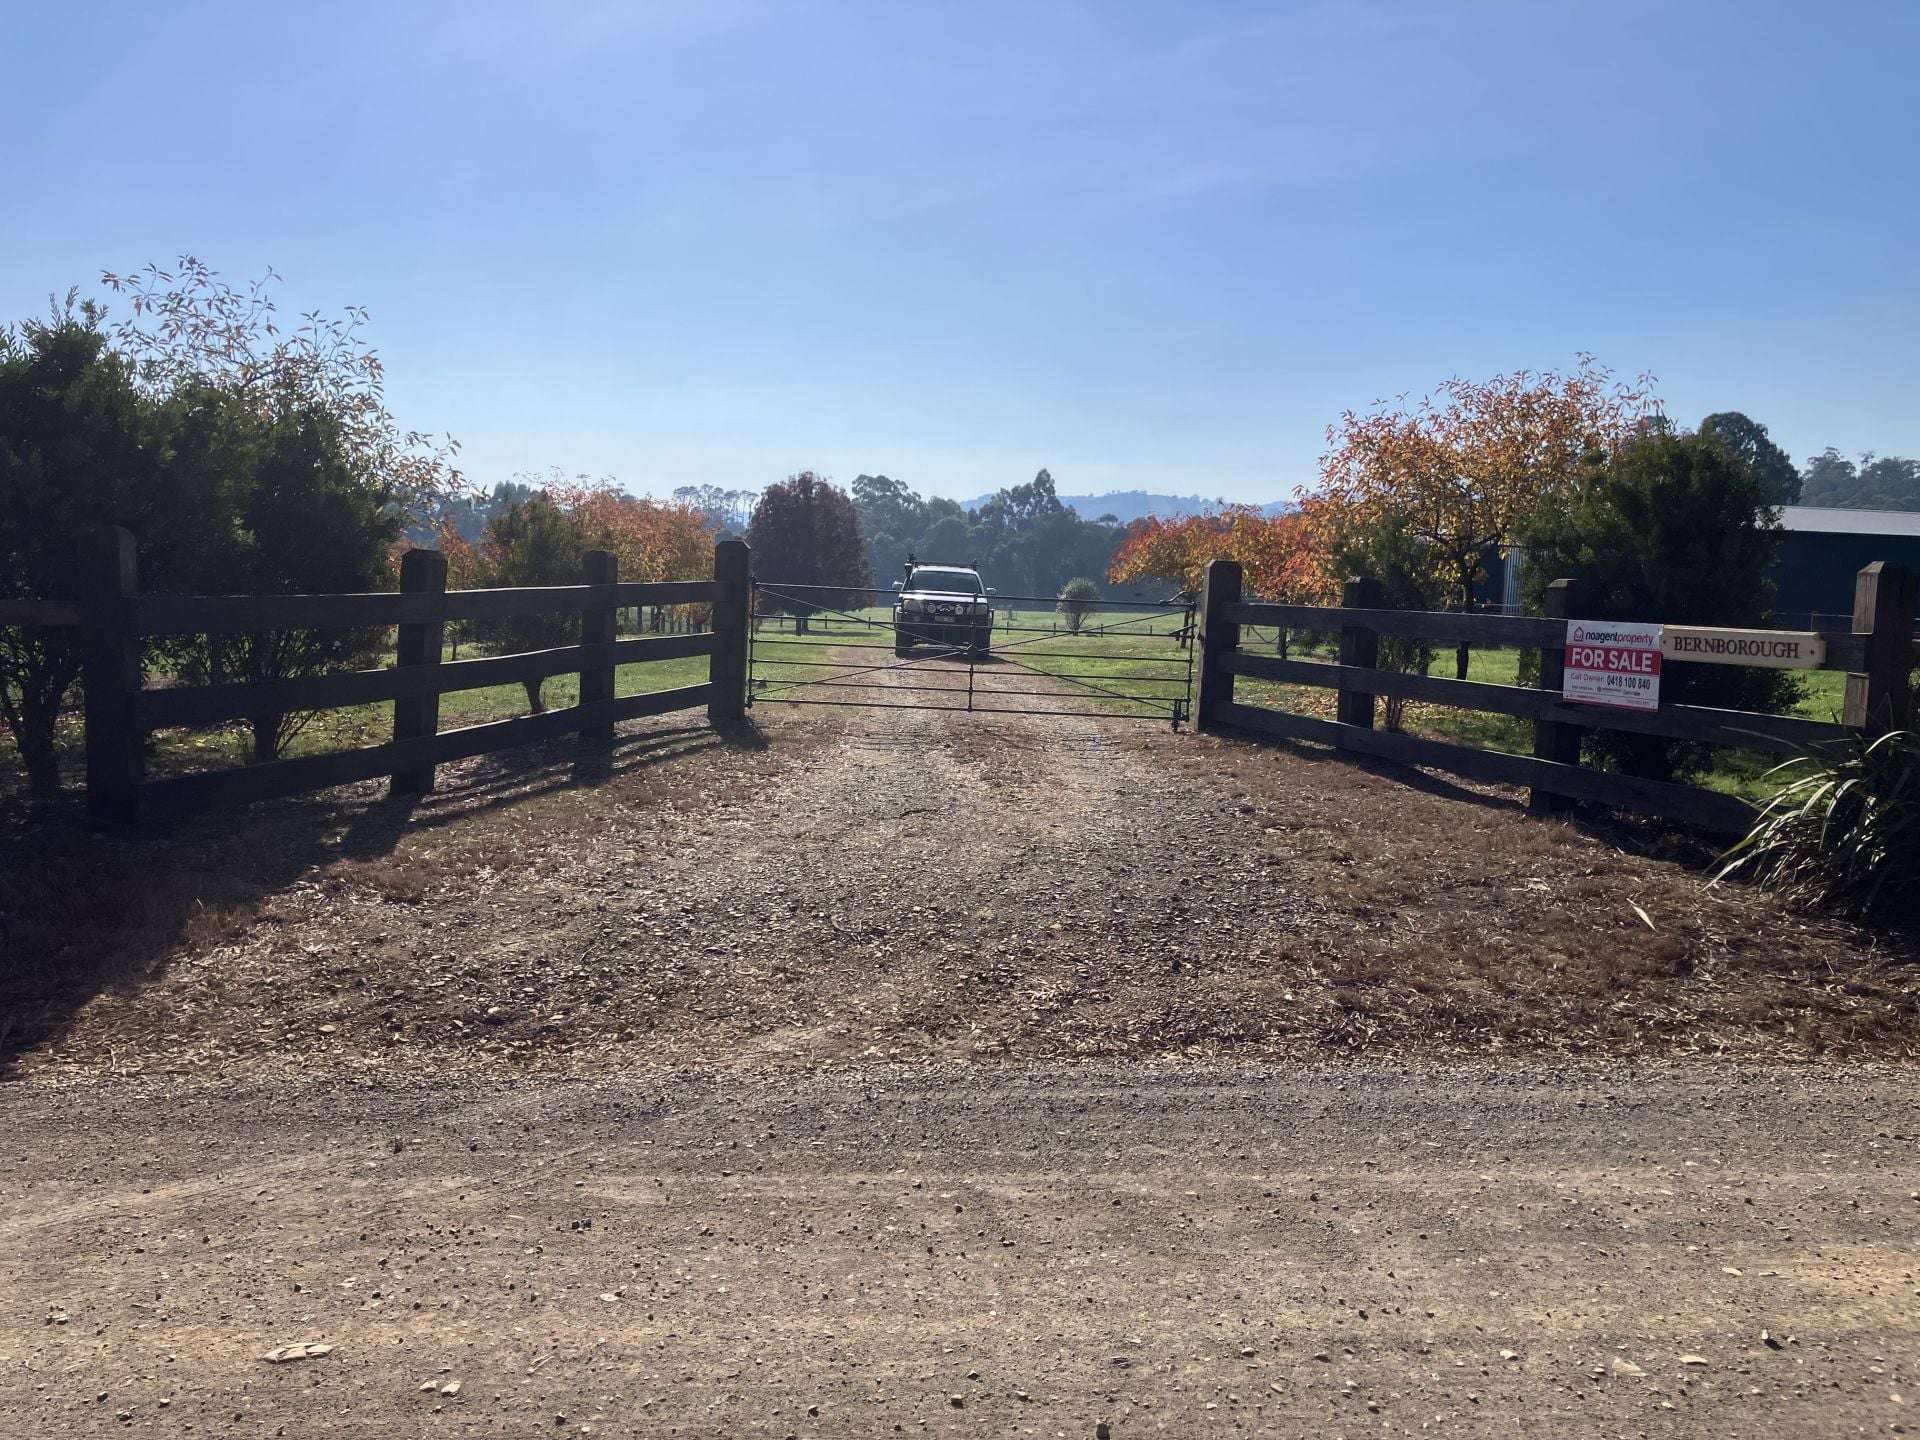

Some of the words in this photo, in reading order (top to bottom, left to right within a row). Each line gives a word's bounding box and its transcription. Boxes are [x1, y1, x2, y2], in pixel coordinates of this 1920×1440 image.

[1586, 631, 1655, 646] noagentproperty
[1673, 636, 1800, 658] BERNBOROUGH
[1571, 647, 1605, 668] FOR
[1608, 650, 1653, 672] SALE
[1607, 675, 1623, 686] 0418
[1625, 677, 1636, 689] 100
[1638, 678, 1651, 690] 840
